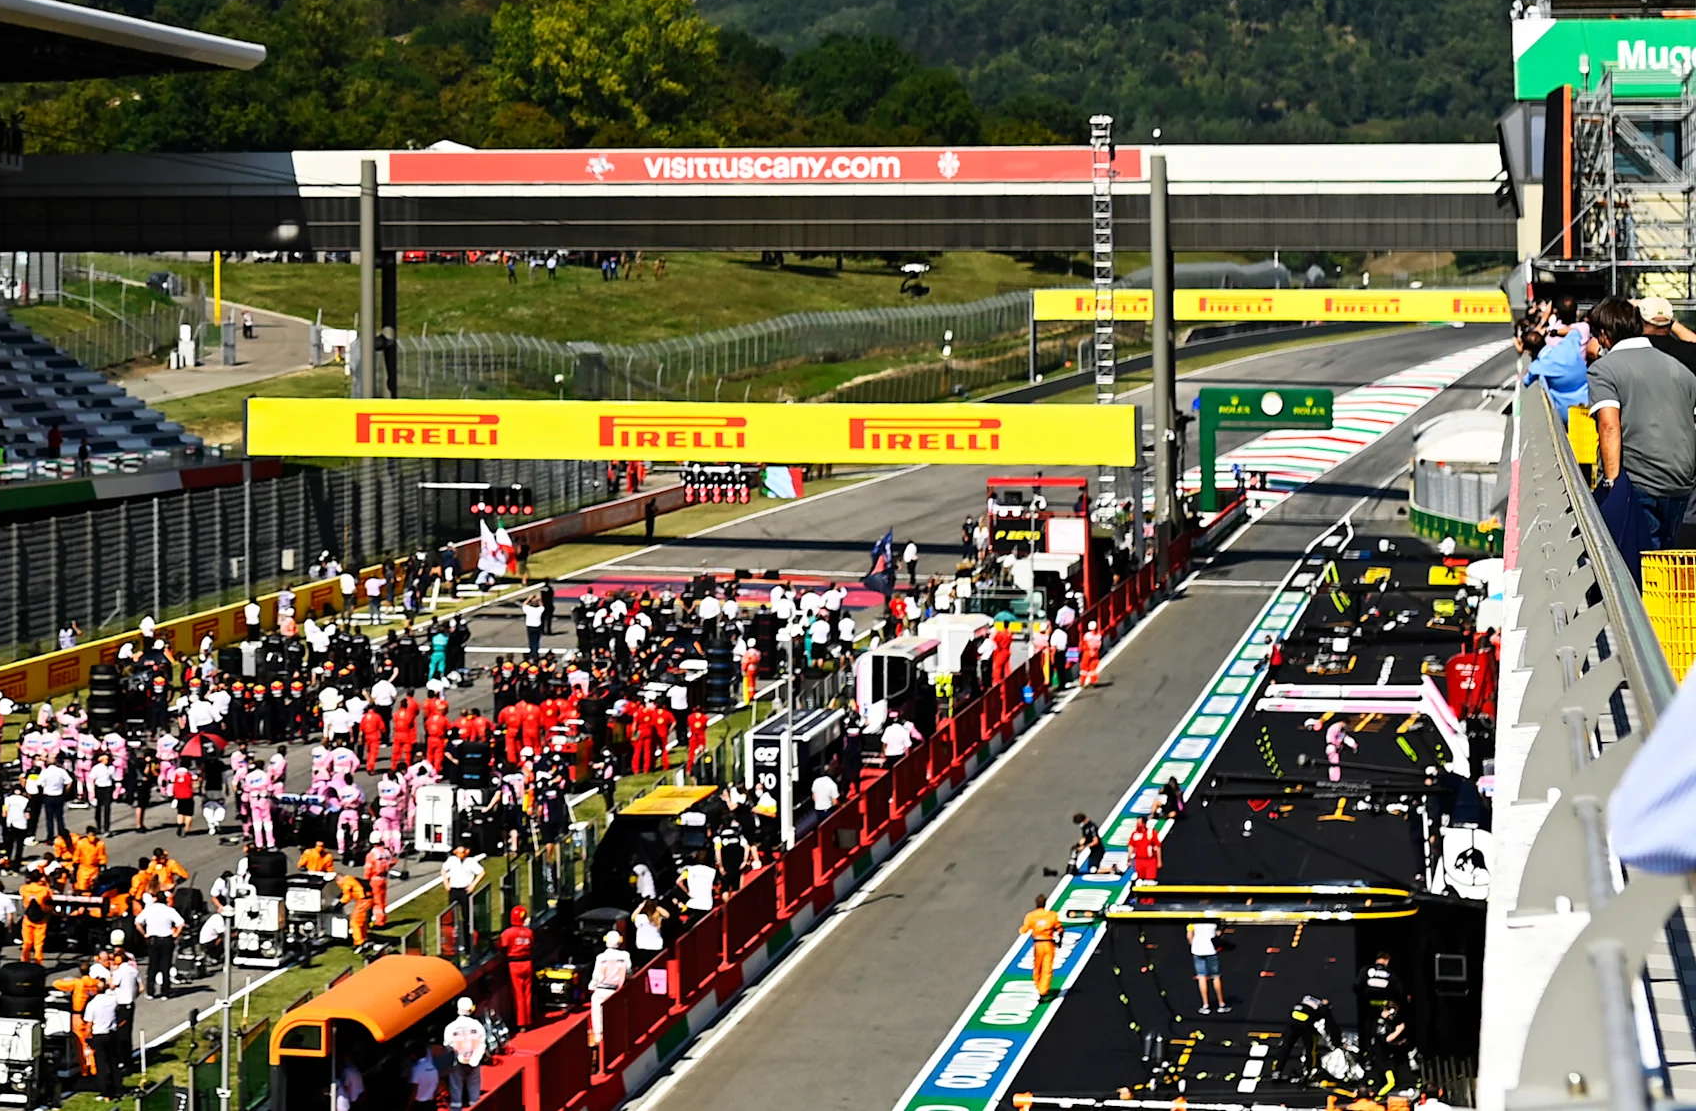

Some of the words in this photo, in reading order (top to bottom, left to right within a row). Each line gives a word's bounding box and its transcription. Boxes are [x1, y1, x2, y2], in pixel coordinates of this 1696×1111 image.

[1617, 39, 1696, 78] Mug
[356, 412, 500, 445] PIRELLI
[599, 416, 747, 448] PIRELLI
[849, 418, 1002, 450] PIRELLI
